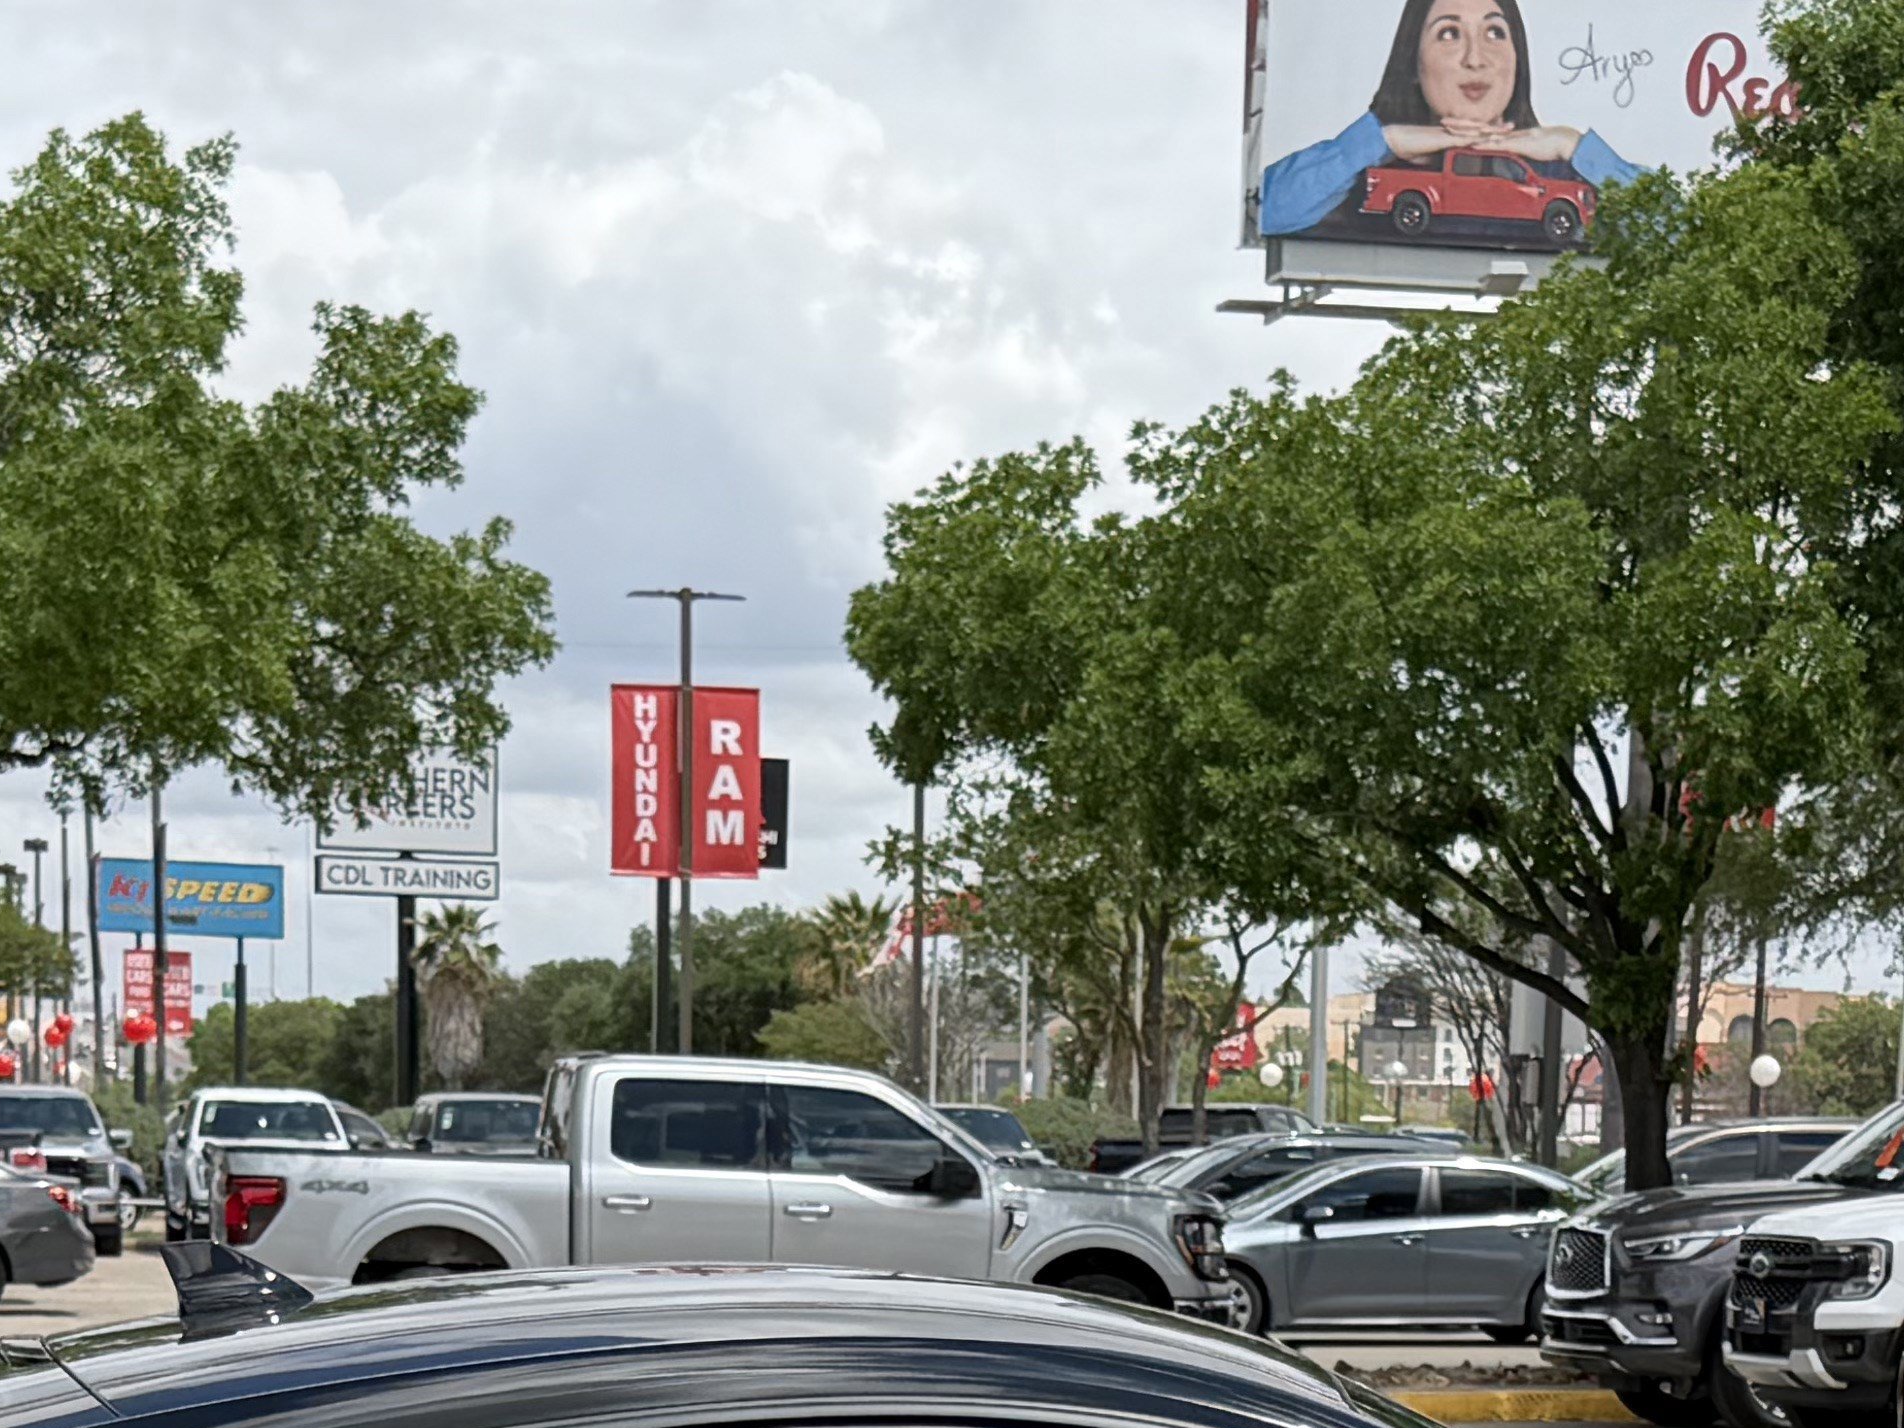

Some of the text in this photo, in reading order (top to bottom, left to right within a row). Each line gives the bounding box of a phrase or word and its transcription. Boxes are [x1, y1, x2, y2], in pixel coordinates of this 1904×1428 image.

[633, 694, 658, 866] HYUNDAI
[706, 719, 745, 846] RAM
[163, 877, 274, 904] SPEED
[326, 864, 491, 890] CDL TRAINING
